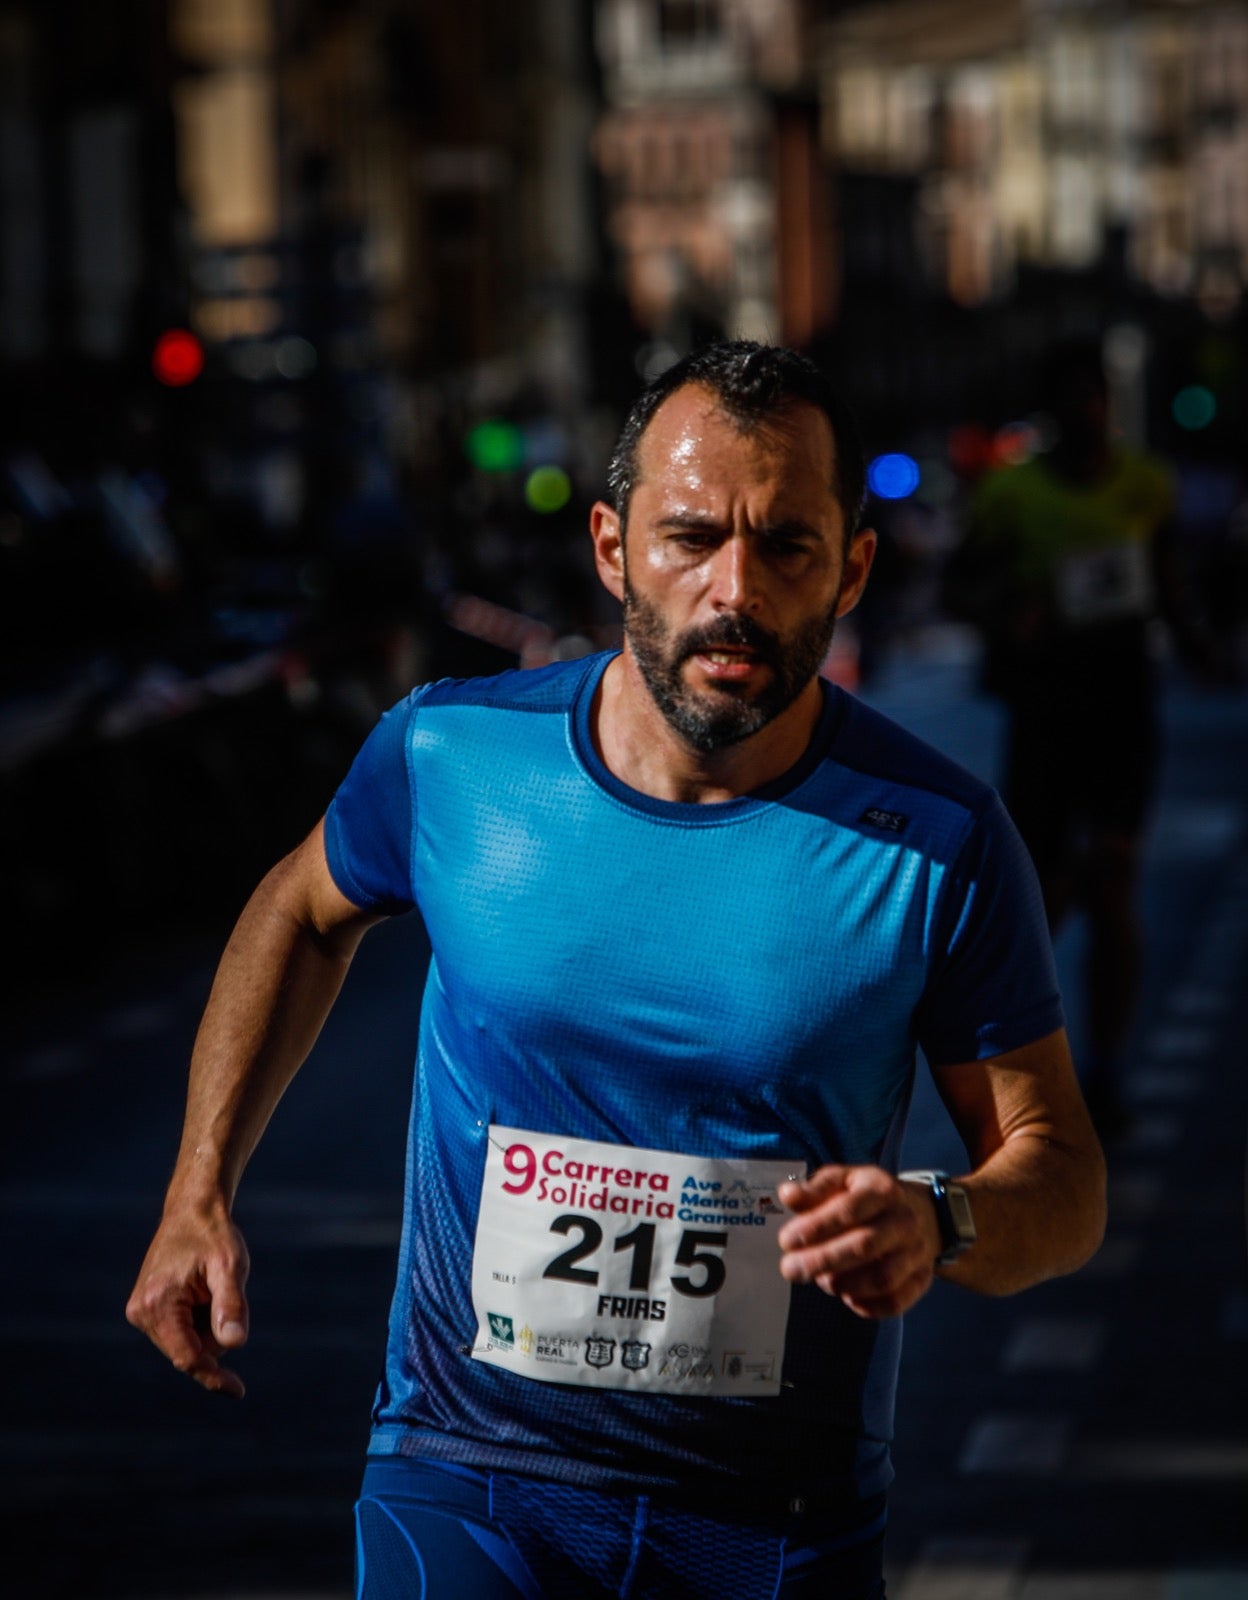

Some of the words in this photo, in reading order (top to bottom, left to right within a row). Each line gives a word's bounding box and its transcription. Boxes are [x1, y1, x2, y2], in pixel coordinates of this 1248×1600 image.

[501, 1144, 537, 1195] 9
[542, 1150, 669, 1192] Carrera
[682, 1175, 722, 1191] Ave
[537, 1177, 675, 1220] Solidaria
[680, 1192, 739, 1210] María
[678, 1209, 766, 1226] Granada
[542, 1214, 729, 1299] 215
[596, 1294, 667, 1322] FRIAS
[537, 1335, 580, 1349] PUERTA
[536, 1346, 565, 1358] REAL
